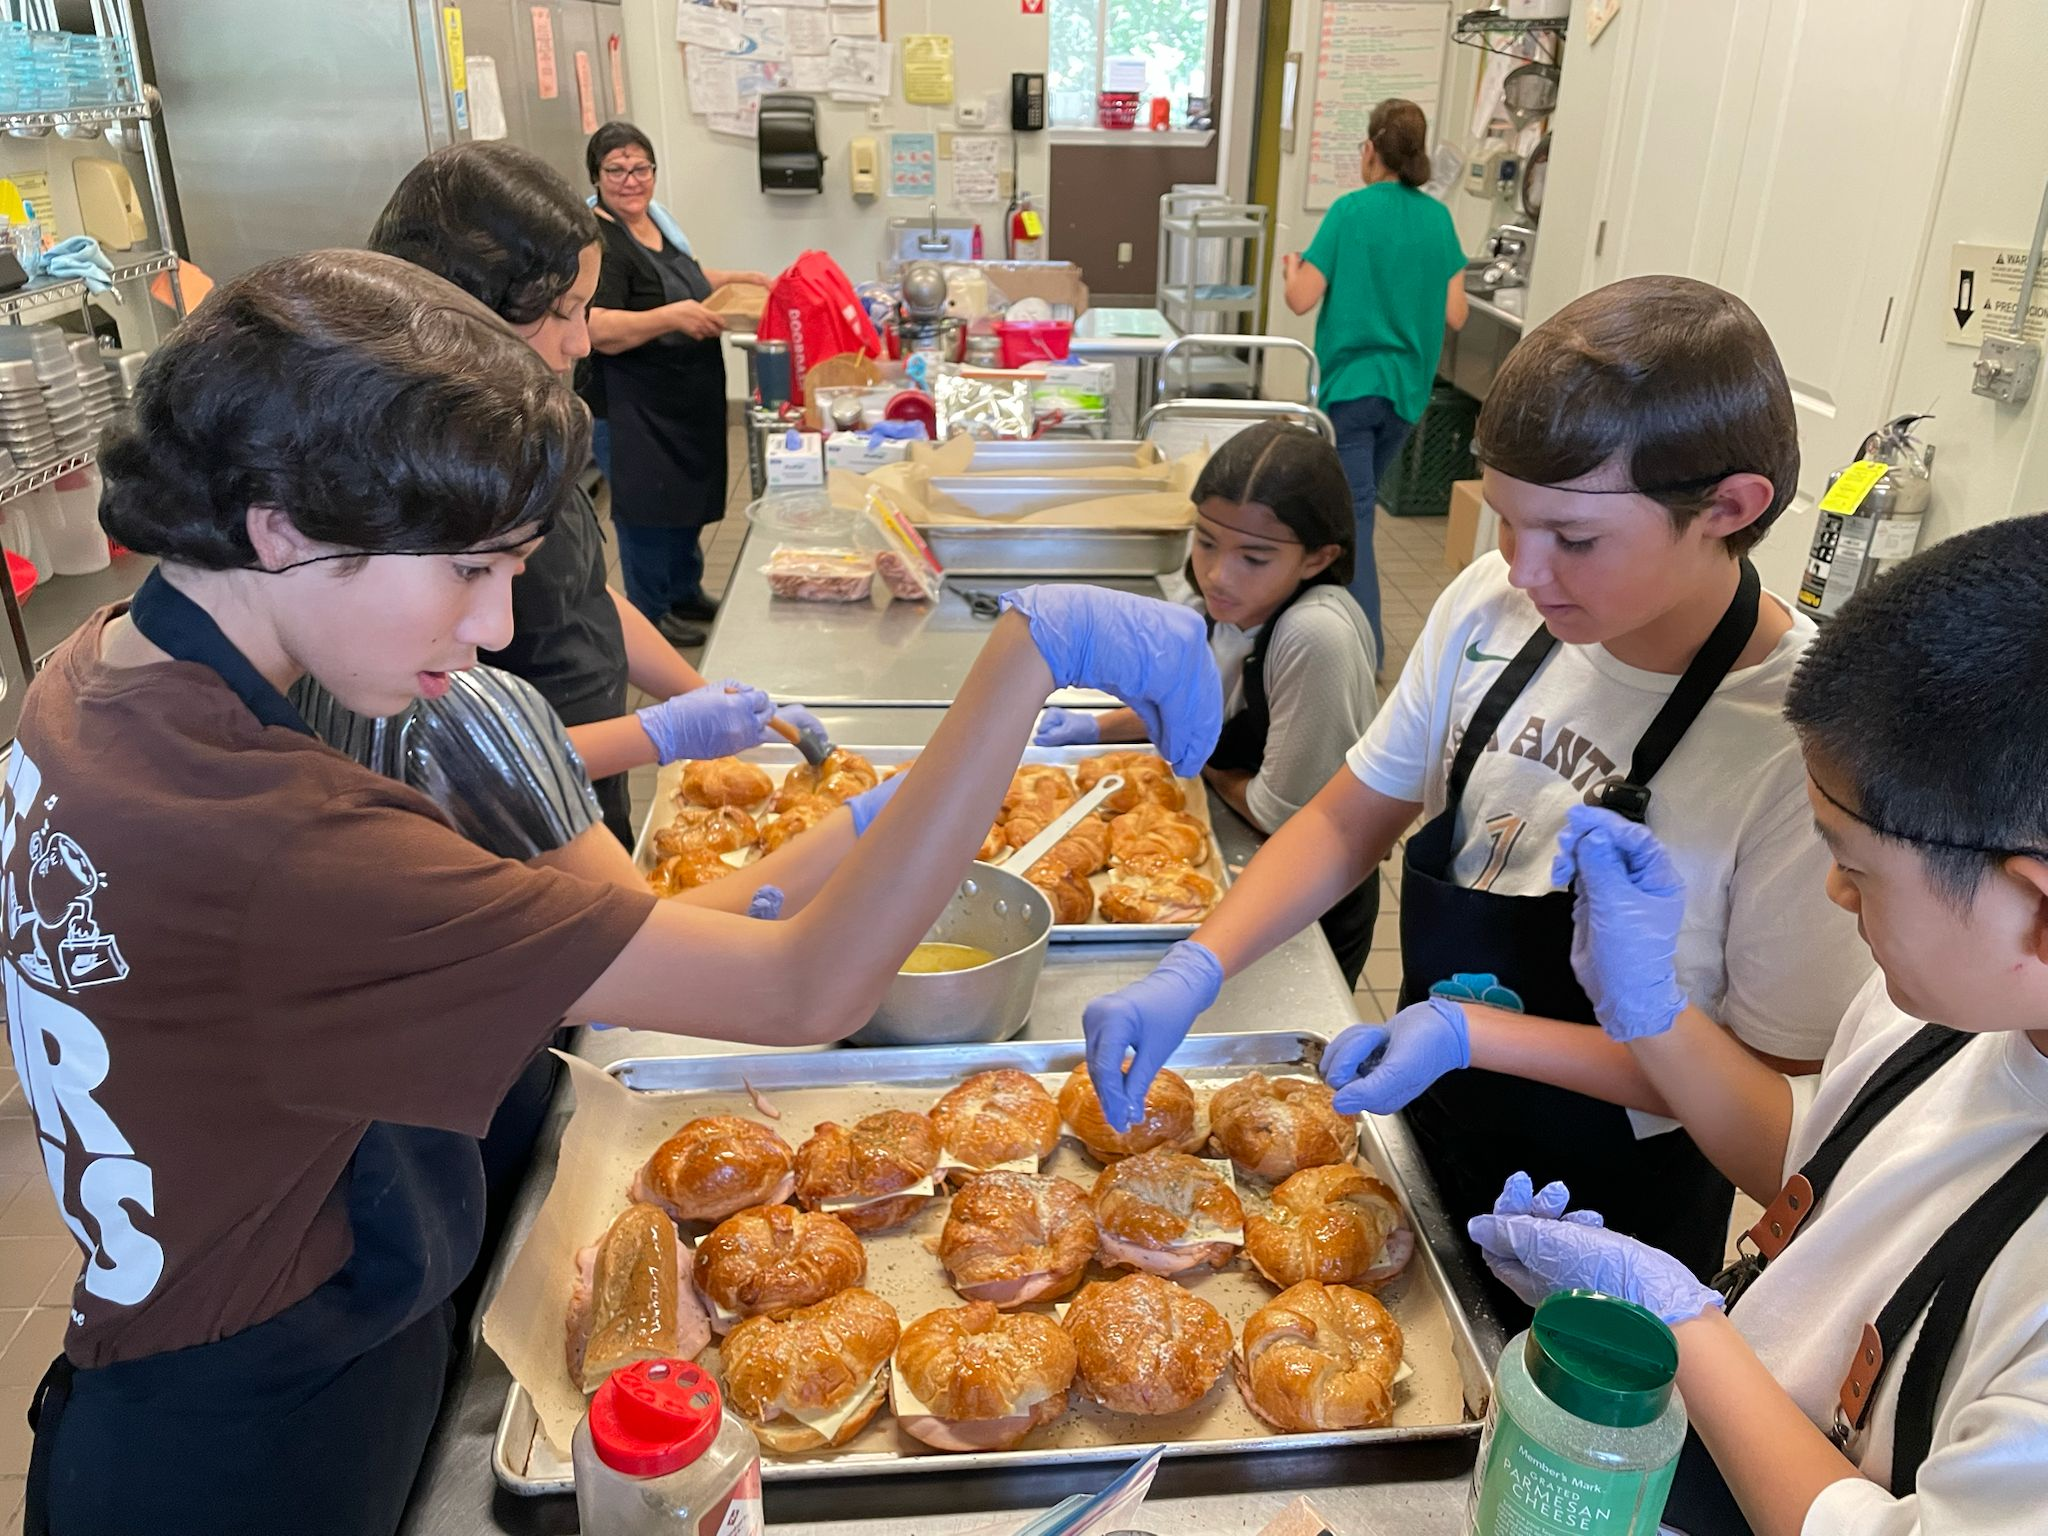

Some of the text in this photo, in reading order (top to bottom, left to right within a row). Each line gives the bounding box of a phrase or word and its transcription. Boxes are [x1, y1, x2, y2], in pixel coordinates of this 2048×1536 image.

[1518, 1445, 1568, 1483] Member's
[1503, 1458, 1611, 1520] PARMESAN
[1512, 1483, 1592, 1531] CHEESE
[1529, 1471, 1581, 1501] GRATED
